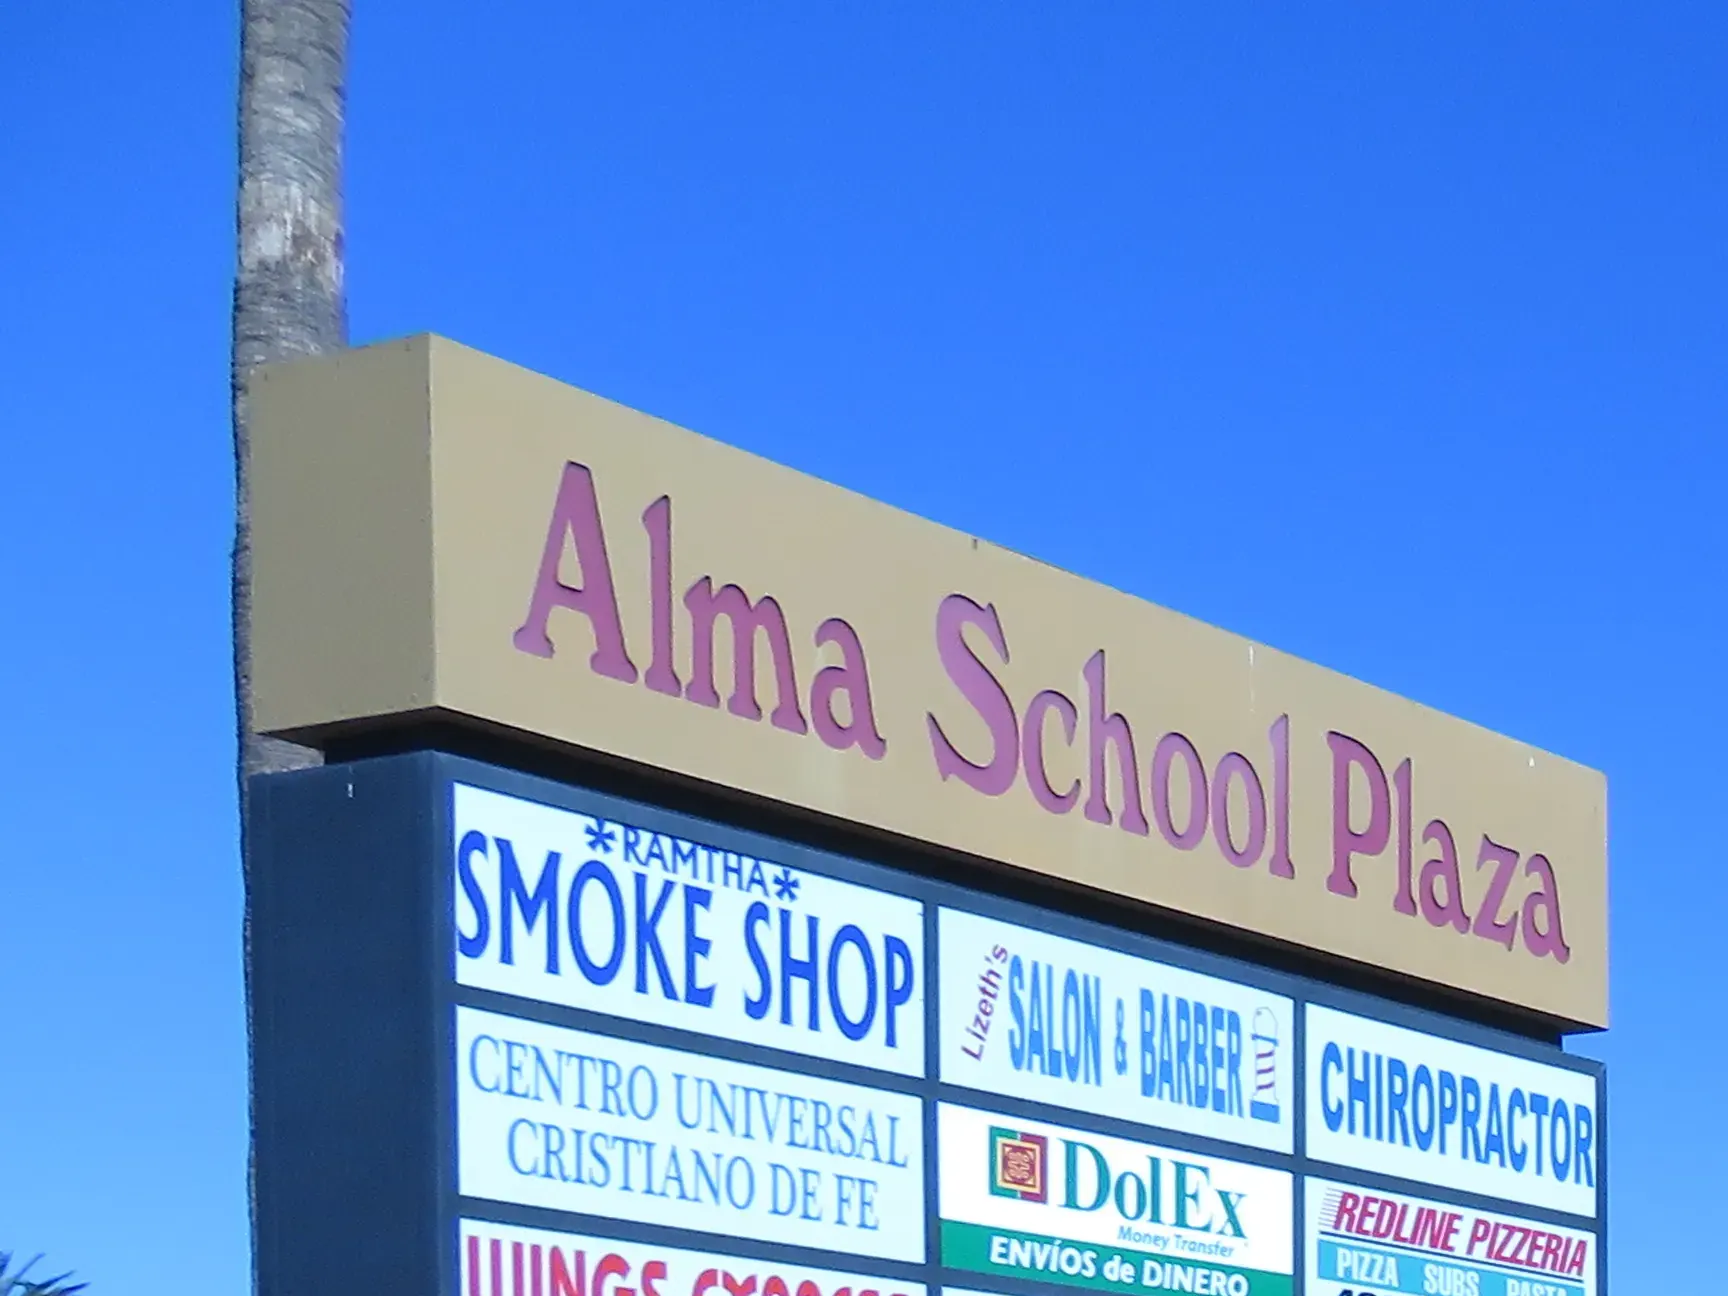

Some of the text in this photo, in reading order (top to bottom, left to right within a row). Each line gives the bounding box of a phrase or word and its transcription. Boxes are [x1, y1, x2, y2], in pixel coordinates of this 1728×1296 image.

[513, 460, 1570, 965] Alma School Plaza
[622, 825, 770, 898] RAMTHA
[456, 829, 914, 1048] SMOKE SHOP
[961, 942, 1009, 1062] Lizeth's
[1007, 954, 1245, 1119] SALON & BARBER
[469, 1034, 908, 1168] CENTRO UNIVERSAL
[1320, 1040, 1595, 1189] CHIROPRACTOR
[507, 1118, 880, 1232] CRISTIANO DE FE
[1057, 1137, 1249, 1241] DolEx
[988, 1233, 1098, 1279] ENVÍOS
[1102, 1254, 1135, 1285] de
[1117, 1224, 1235, 1258] Money Transfer
[1332, 1190, 1589, 1277] REDLINE PIZZERIA
[1335, 1246, 1399, 1289] PIZZA
